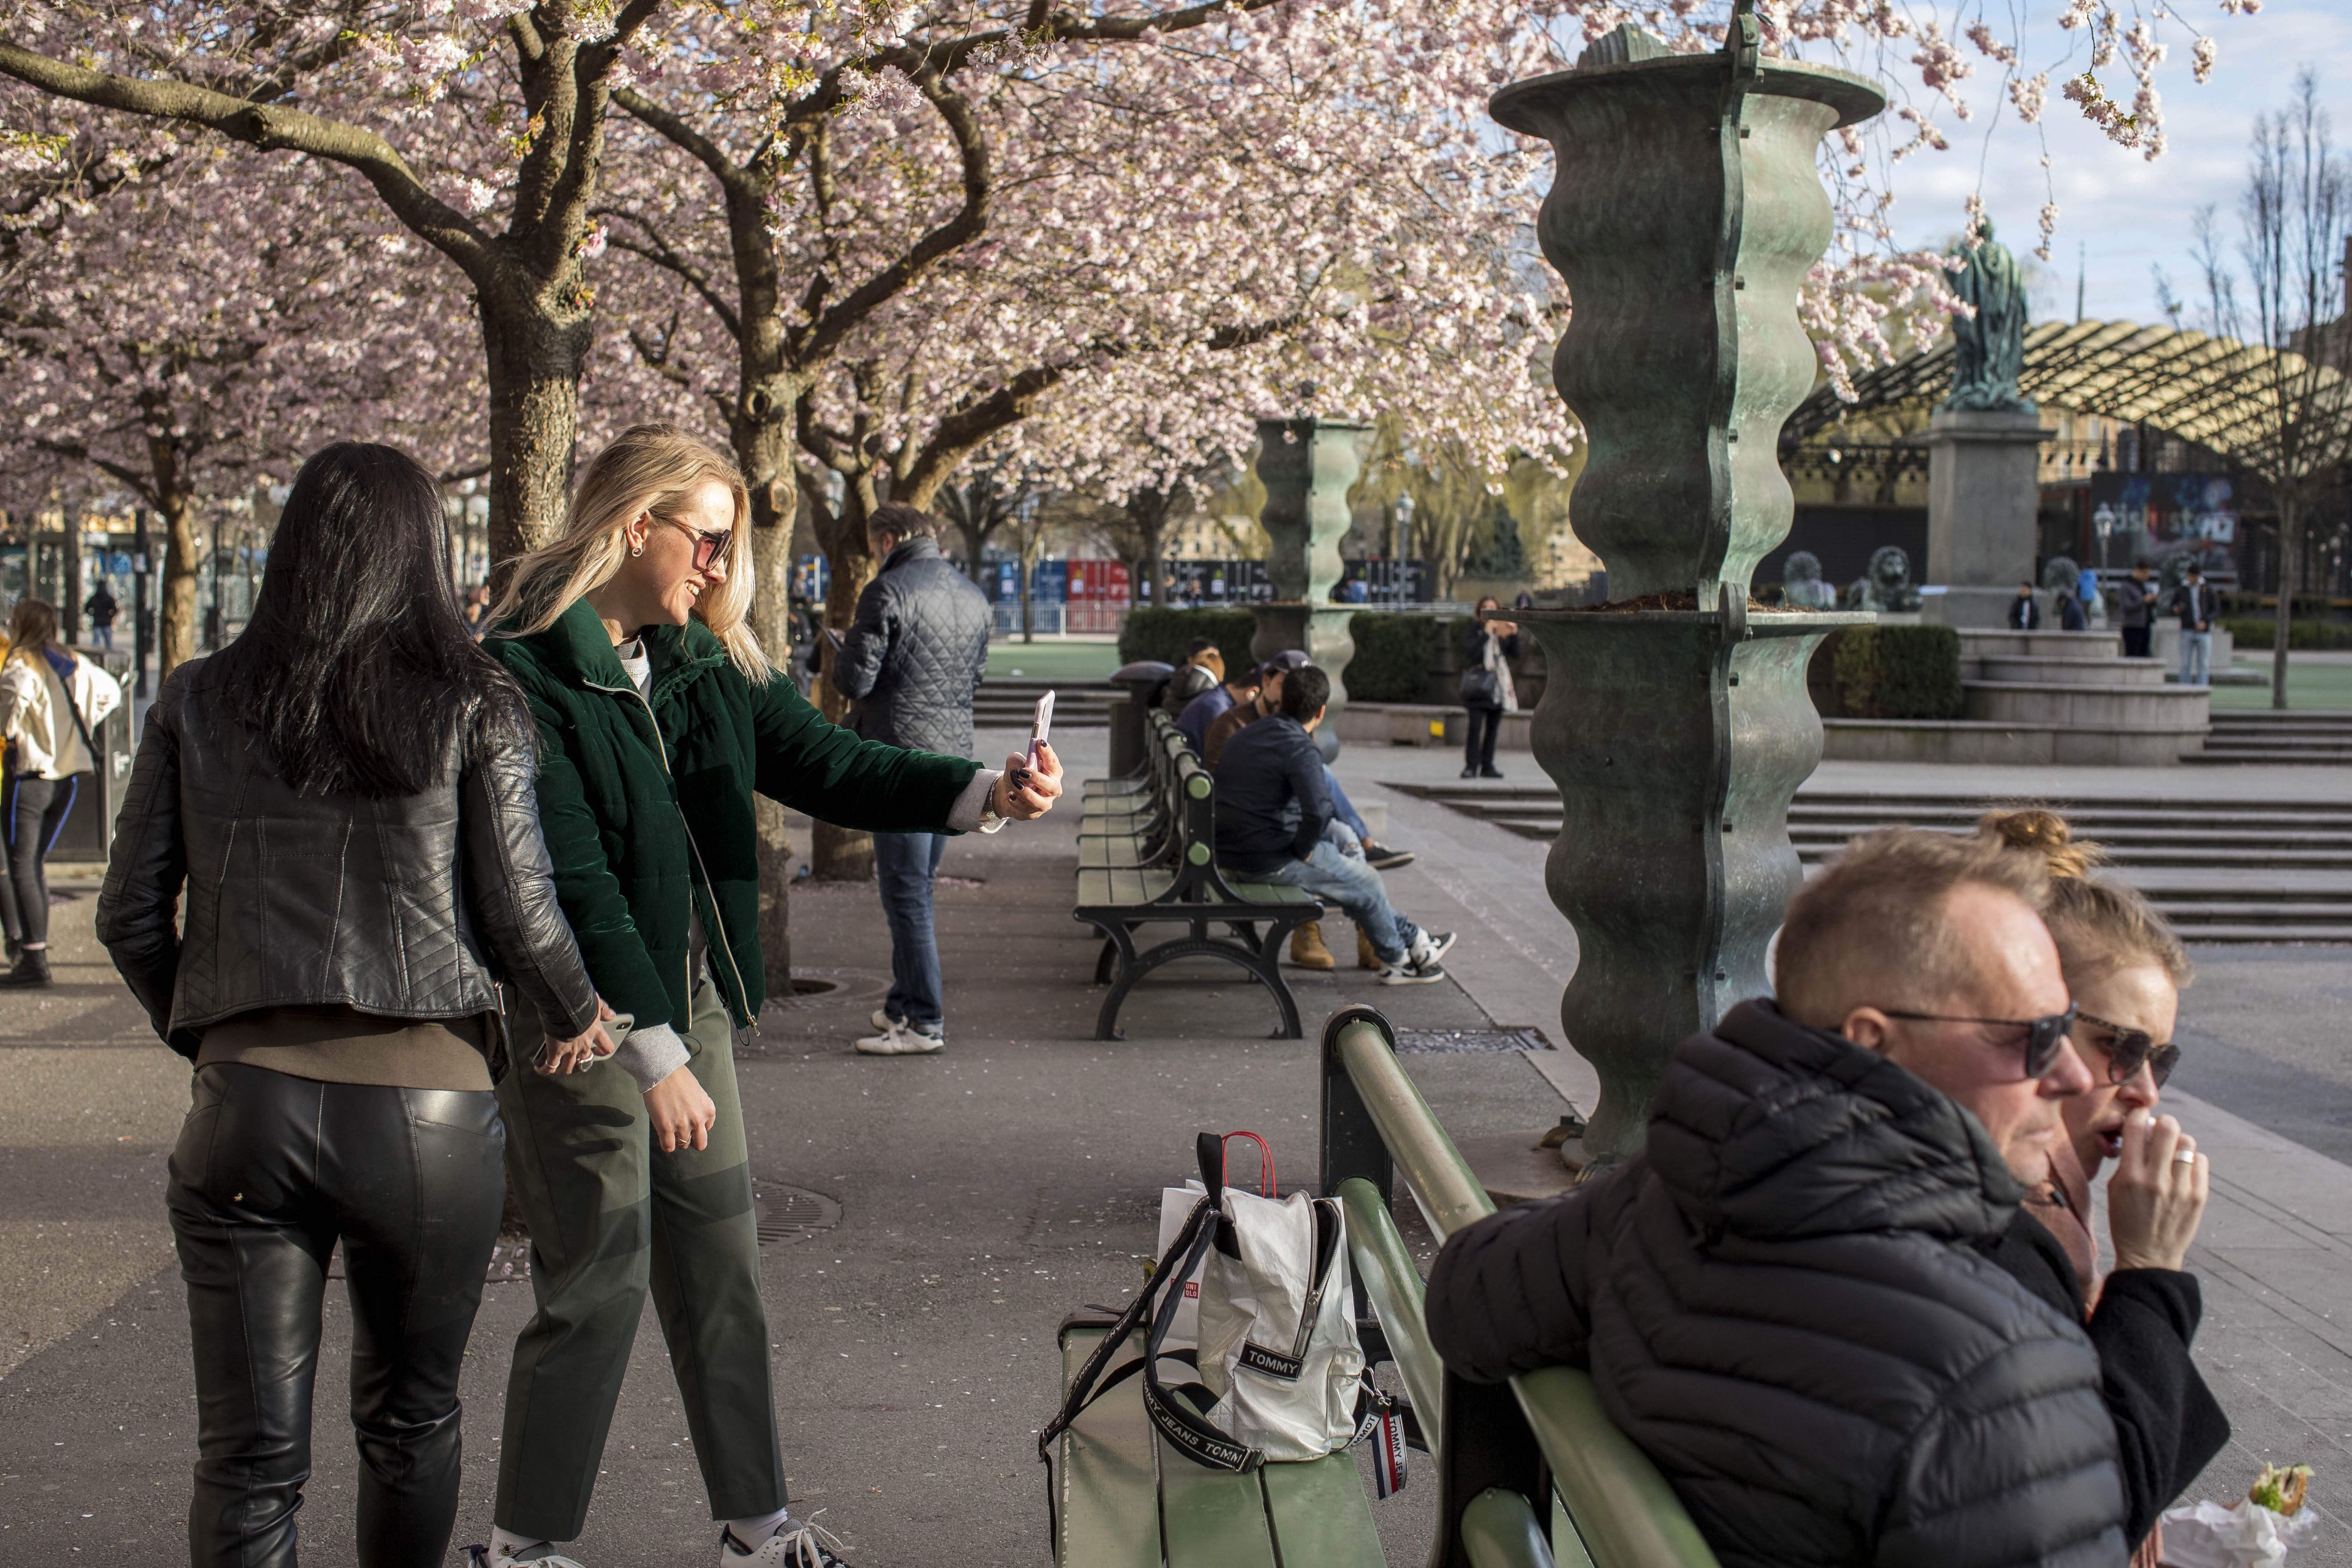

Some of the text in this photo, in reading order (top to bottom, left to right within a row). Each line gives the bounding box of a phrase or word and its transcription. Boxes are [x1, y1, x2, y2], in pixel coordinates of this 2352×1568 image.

[1249, 1350, 1298, 1374] TOMMY
[1161, 1415, 1199, 1445] JEANS
[1206, 1443, 1242, 1463] TOMM
[1389, 1418, 1402, 1457] TOMMY
